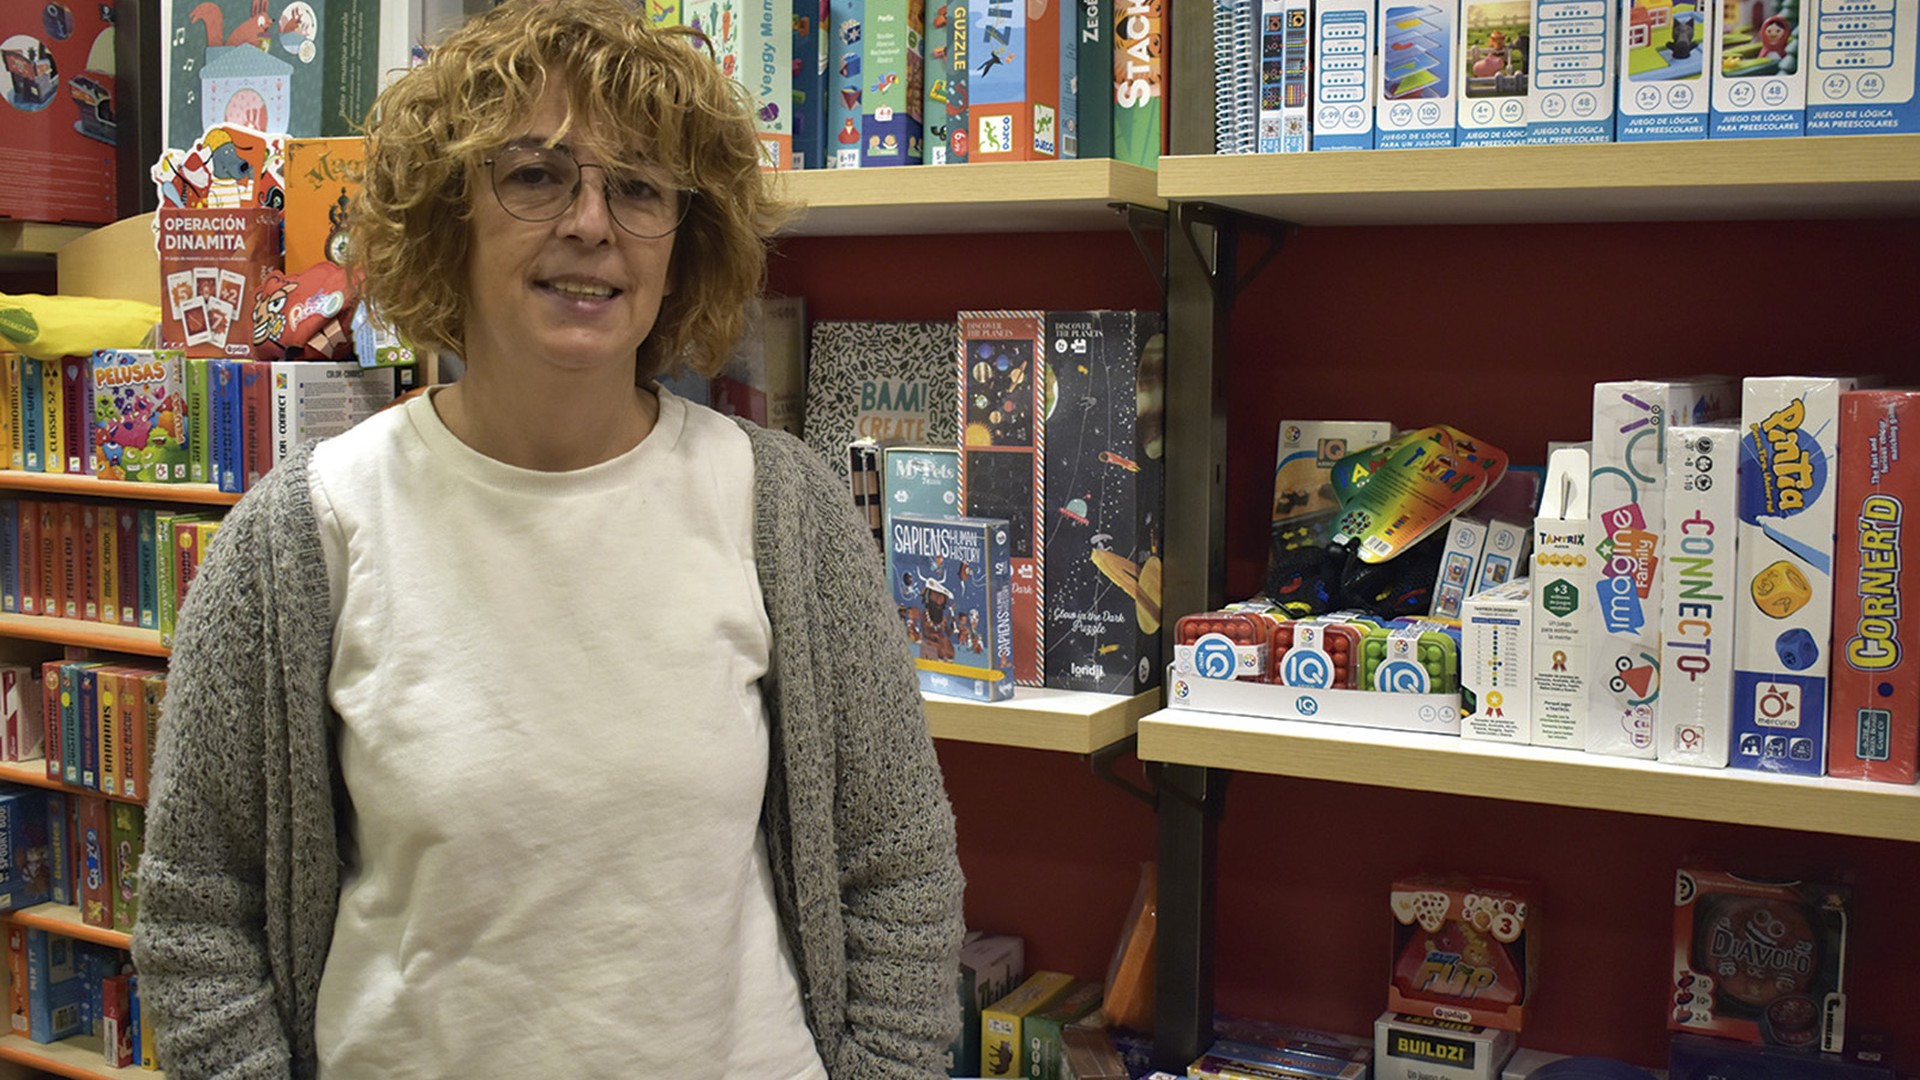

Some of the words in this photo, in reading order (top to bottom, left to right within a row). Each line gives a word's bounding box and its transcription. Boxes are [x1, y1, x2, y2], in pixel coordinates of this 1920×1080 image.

[954, 6, 967, 71] GUZZLE
[760, 43, 776, 97] Veggy
[1768, 86, 1782, 96] 48
[1827, 79, 1844, 89] 4-7
[1863, 78, 1878, 88] 48
[1640, 91, 1656, 101] 3-6
[1673, 89, 1687, 98] 48
[1734, 87, 1750, 97] 4-7
[1577, 98, 1591, 107] 48
[1629, 117, 1656, 126] JUEGO
[1657, 117, 1669, 125] DE
[1671, 115, 1698, 125] LÓGICA
[1722, 115, 1750, 123] JUEGO
[1751, 114, 1762, 122] DE
[1763, 112, 1794, 122] LÓGICA
[1813, 111, 1843, 119] JUEGO
[1846, 110, 1857, 119] DE
[1858, 109, 1893, 118] LÓGICA
[1560, 127, 1571, 135] DE
[1573, 125, 1604, 134] LÓGICA
[1624, 126, 1646, 134] PARA
[1647, 125, 1704, 134] PREESCOLARES
[1716, 124, 1737, 132] PARA
[1739, 122, 1799, 131] PREESCOLARES
[1808, 120, 1831, 129] PARA
[1832, 118, 1899, 128] PREESCOLARES
[1382, 133, 1406, 141] JUEGO
[1419, 131, 1450, 140] LÓGICA
[1401, 140, 1413, 148] UN
[1414, 139, 1452, 147] JUGADOR
[1465, 132, 1490, 140] JUEGO
[1528, 136, 1549, 144] PARA
[1551, 135, 1609, 143] PREESCOLARES
[164, 213, 246, 231] OPERACIÓN
[164, 234, 246, 250] DINAMITA
[1055, 322, 1092, 330] DISCOVER
[94, 361, 167, 389] PELUSAS
[48, 391, 56, 404] 52
[860, 380, 928, 412] BAM!
[10, 386, 19, 450] ANIMOMIX
[279, 394, 287, 435] CONNECT
[48, 406, 57, 452] CLASSIC
[858, 415, 926, 442] CREATE
[1318, 440, 1346, 460] IQ
[1868, 437, 1877, 454] and
[1870, 455, 1880, 471] fast
[894, 523, 949, 558] SAPIENS
[950, 529, 977, 547] HUMAN
[1539, 531, 1585, 546] TANTRIX
[103, 531, 111, 565] SCHOOL
[950, 546, 981, 563] HISTORY
[1610, 508, 1638, 629] Imagine
[1636, 539, 1653, 588] Family
[103, 569, 111, 598] MAGIC
[1011, 583, 1033, 594] Dark
[1553, 584, 1568, 595] +3
[1846, 496, 1901, 669] CORNER'D
[1667, 509, 1724, 682] CONNECTO
[1053, 607, 1077, 622] Glow
[1086, 609, 1101, 621] the
[1102, 610, 1126, 623] Dark
[997, 611, 1012, 658] SAPIENS
[1071, 619, 1107, 635] Puzzle
[1290, 656, 1323, 685] IQ
[1384, 667, 1420, 694] IQ
[1298, 698, 1316, 712] IQ
[122, 711, 133, 744] RESCUE
[1757, 716, 1797, 727] mercurio
[103, 705, 113, 773] BANANAS
[1499, 917, 1513, 935] 3
[28, 949, 38, 964] IT
[1711, 926, 1812, 973] DIAVOLO
[30, 968, 38, 991] MIX
[1412, 961, 1497, 999] FLIP
[1397, 1036, 1465, 1061] BUILDZI
